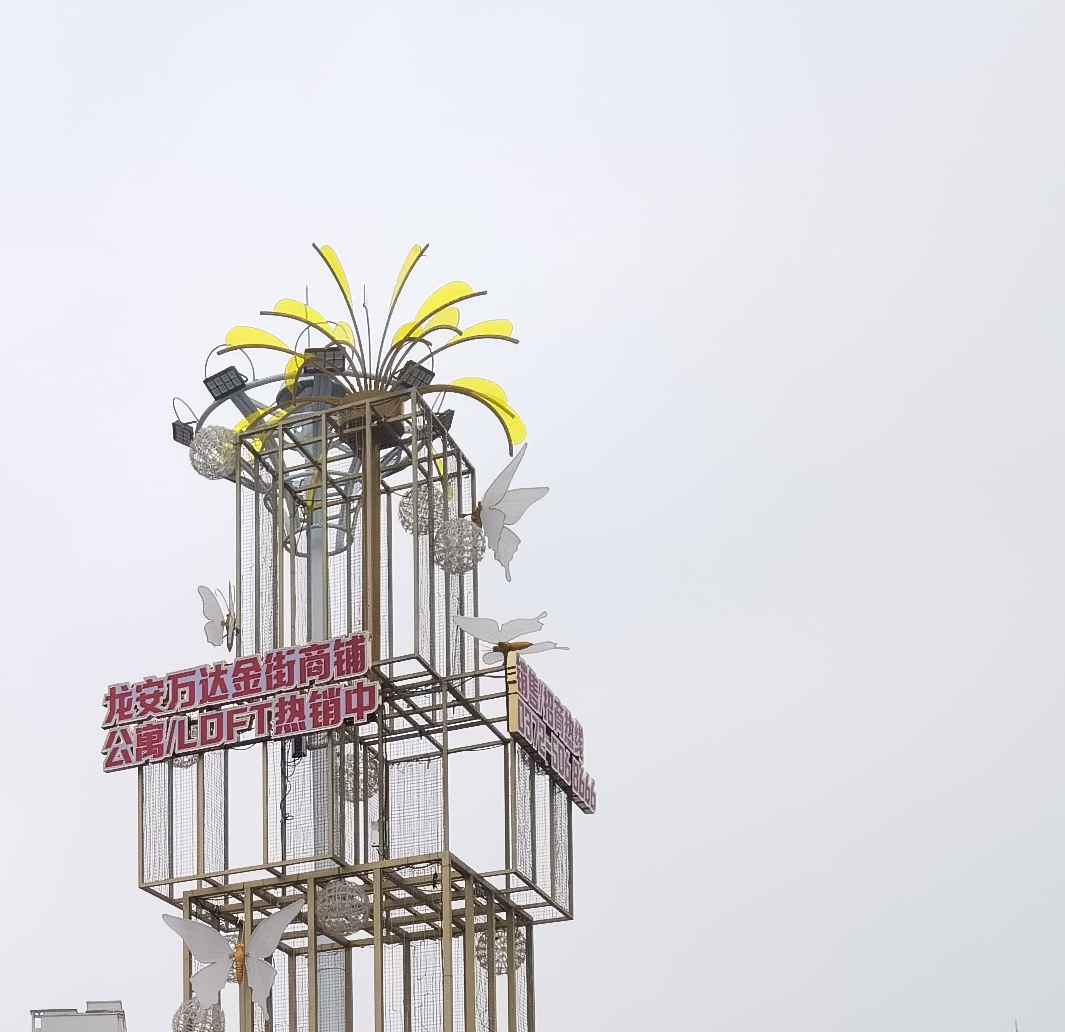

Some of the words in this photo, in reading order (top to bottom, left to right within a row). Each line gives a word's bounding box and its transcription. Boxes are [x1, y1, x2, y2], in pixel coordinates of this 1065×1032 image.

[103, 634, 368, 726] 龙安万达金街商铺
[103, 682, 378, 768] 公寓/LOFT热销中
